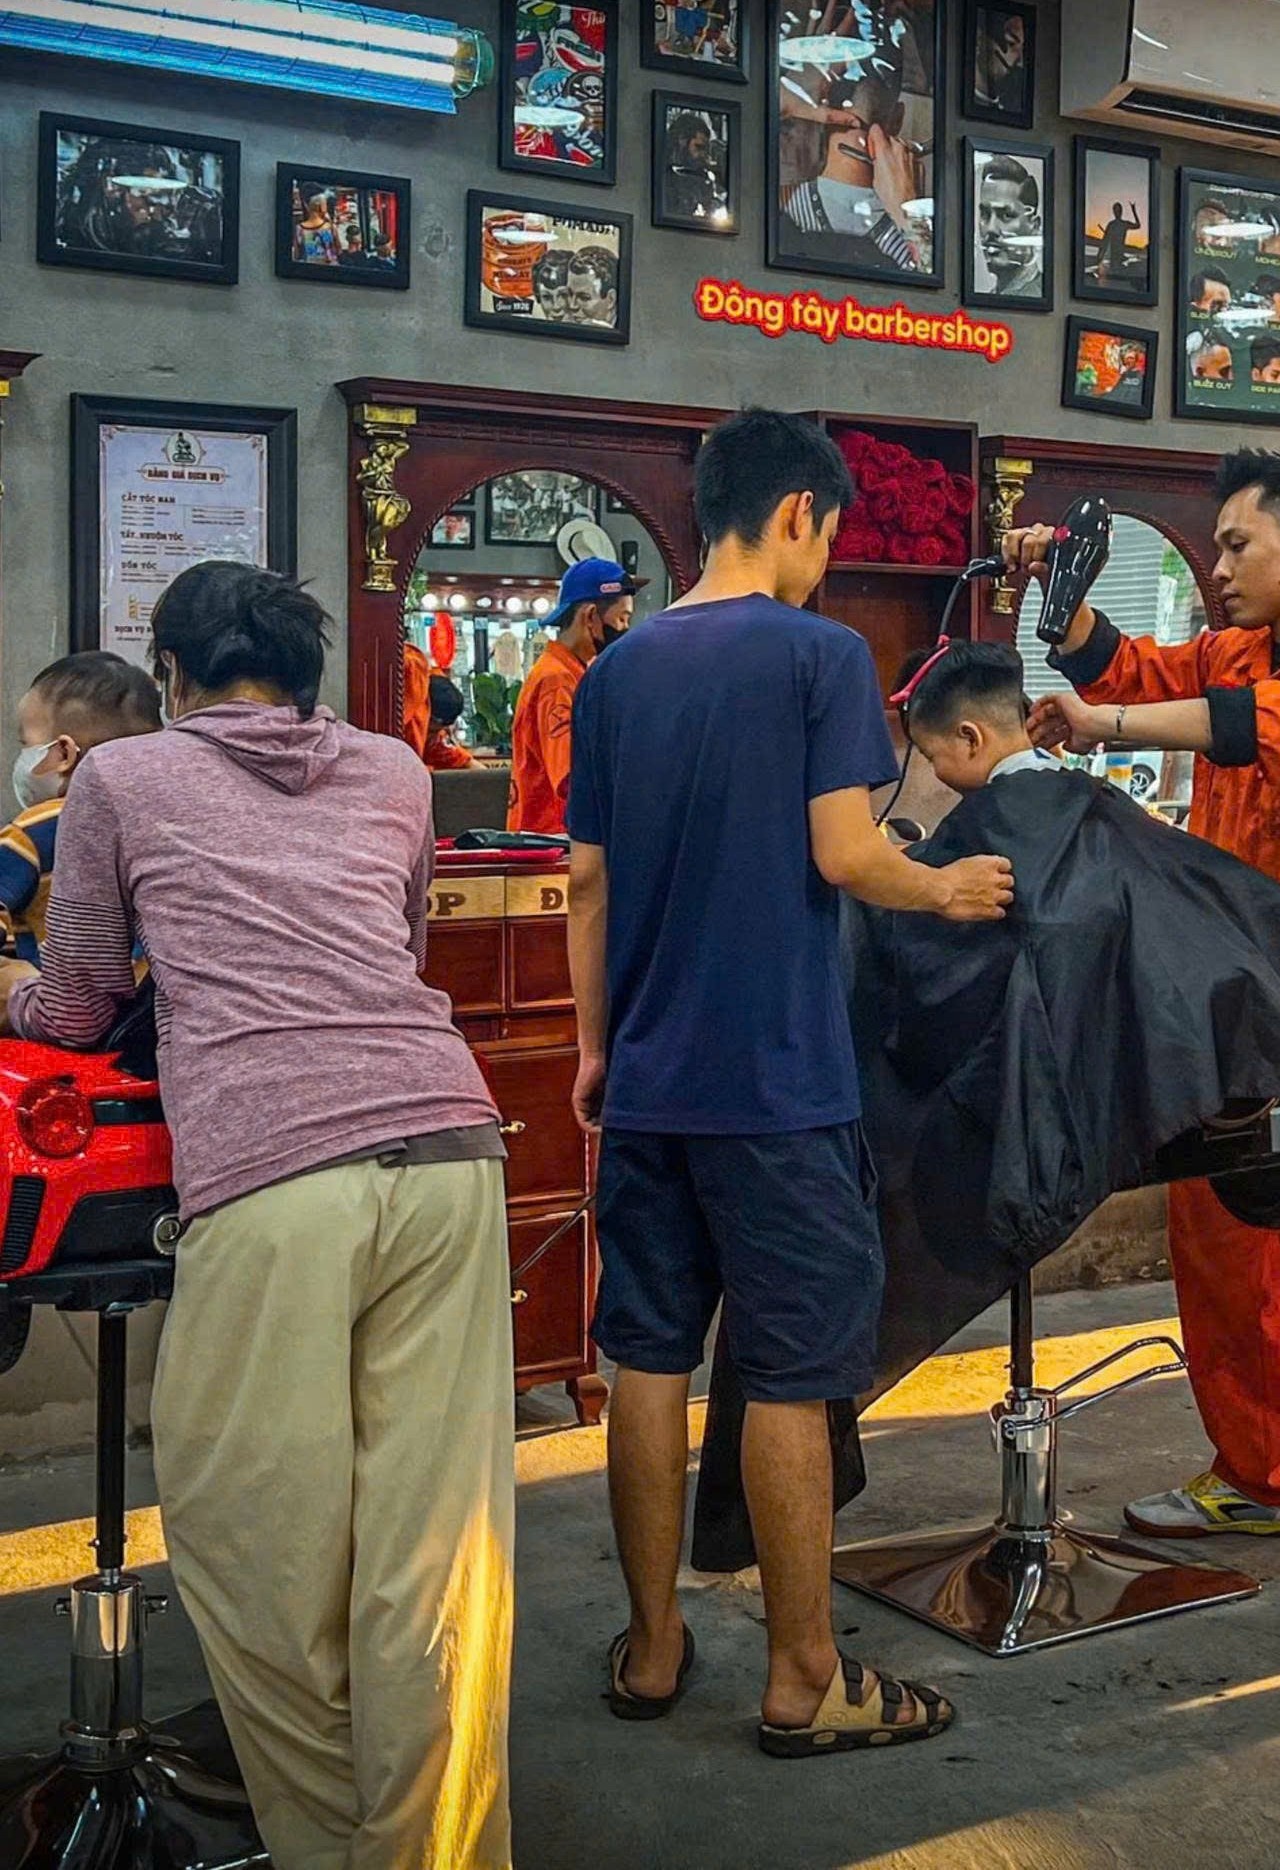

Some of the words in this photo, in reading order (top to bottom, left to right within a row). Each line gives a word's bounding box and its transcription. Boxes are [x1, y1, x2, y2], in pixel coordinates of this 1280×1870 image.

[701, 283, 785, 329] Đông
[791, 296, 840, 337] tây
[846, 301, 1009, 357] barbershop
